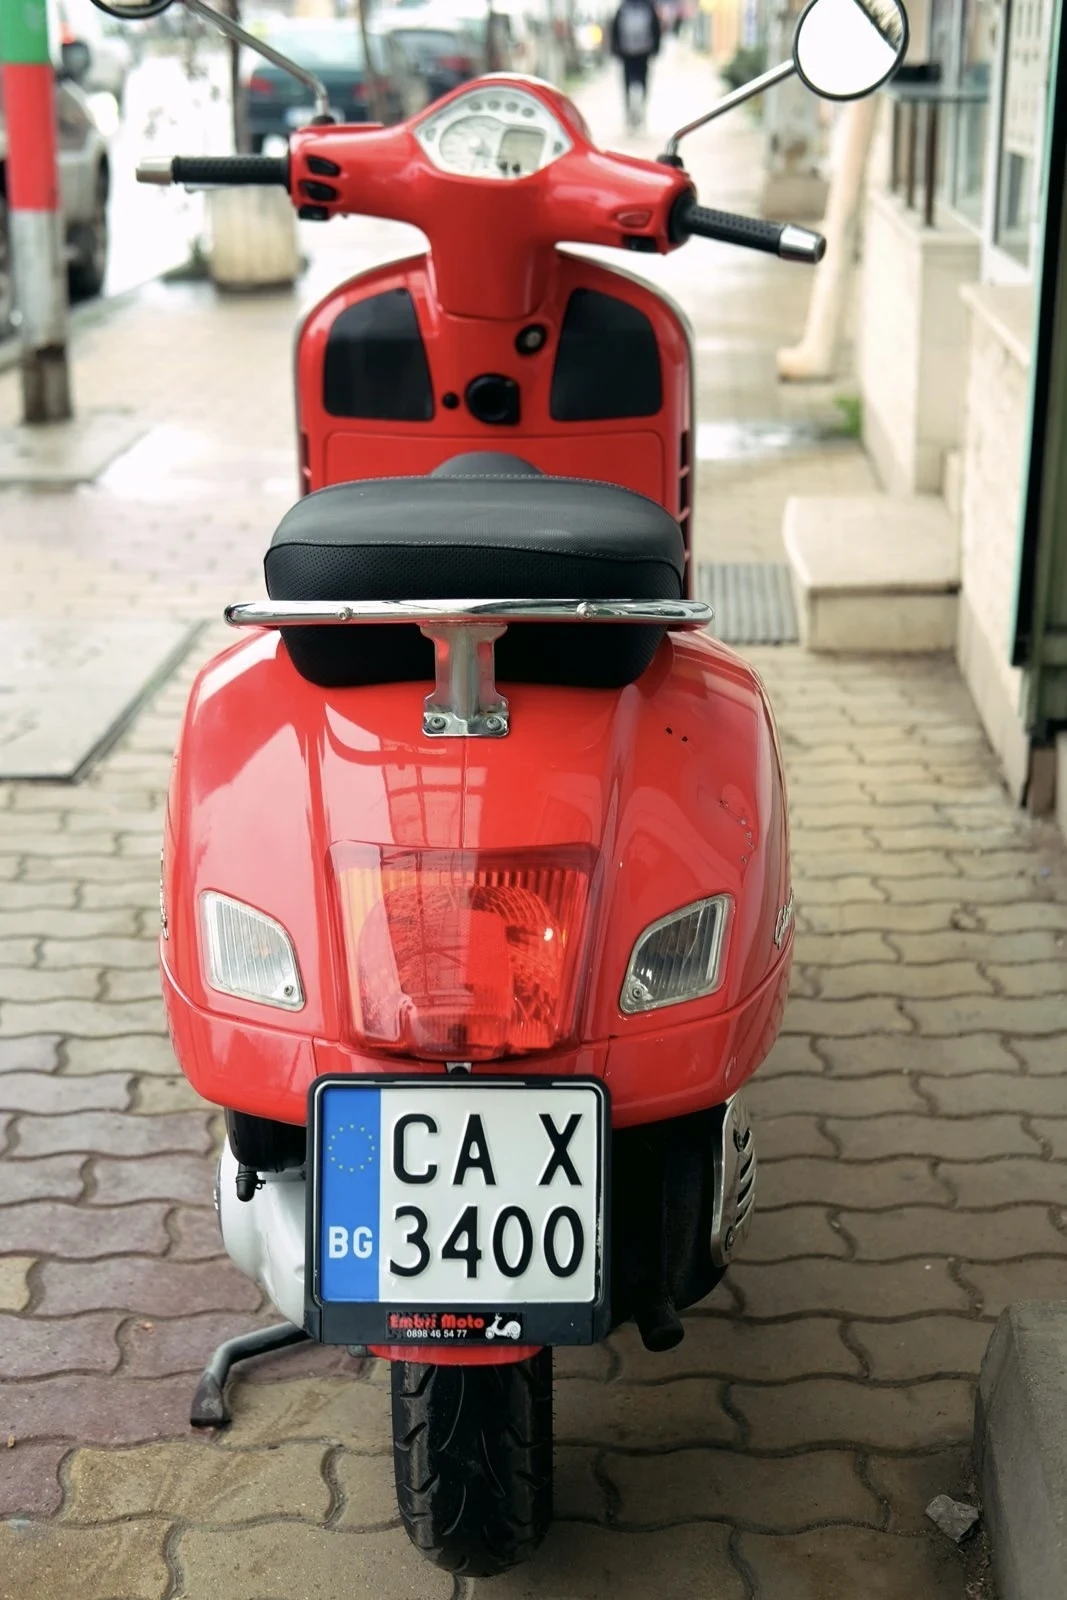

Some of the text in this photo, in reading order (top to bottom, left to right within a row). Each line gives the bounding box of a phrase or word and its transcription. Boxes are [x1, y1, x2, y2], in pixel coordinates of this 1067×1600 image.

[393, 1113, 583, 1185] CA X
[328, 1226, 373, 1259] BG
[389, 1205, 585, 1278] 3400
[406, 1329, 468, 1338] 0898 46 54 77
[441, 1313, 485, 1329] Moto
